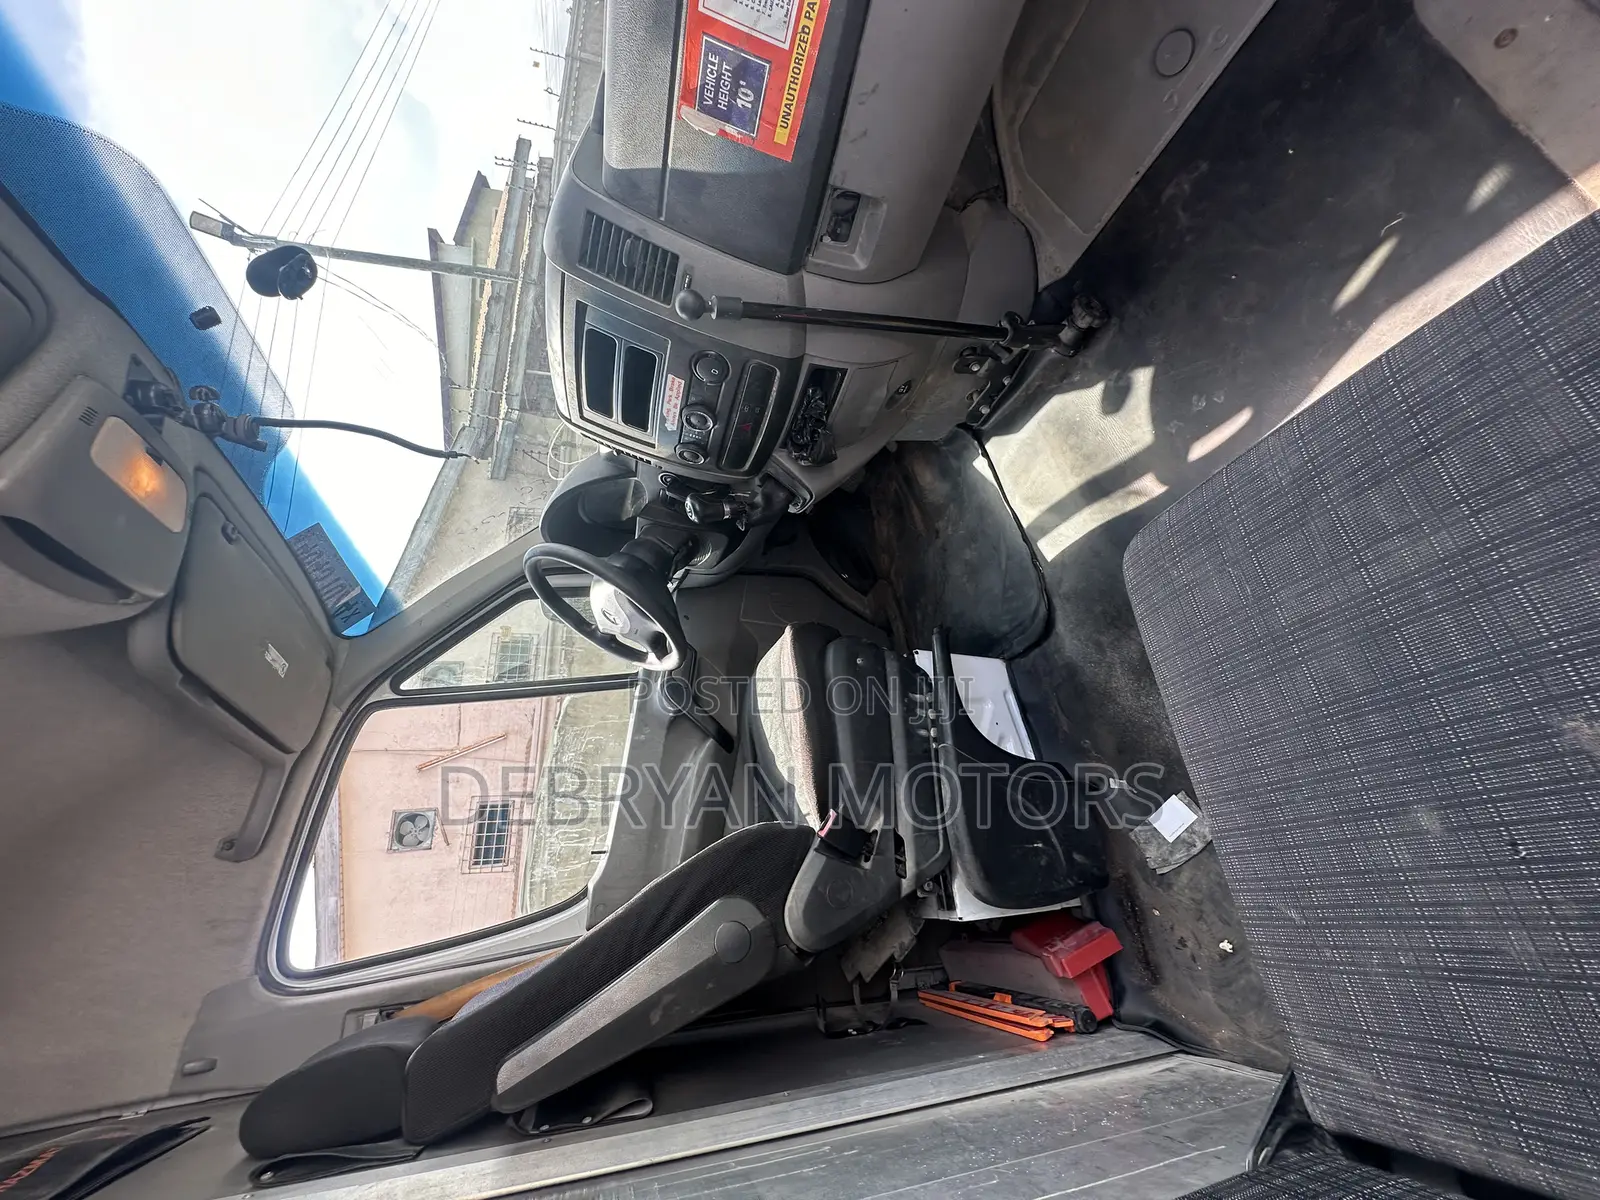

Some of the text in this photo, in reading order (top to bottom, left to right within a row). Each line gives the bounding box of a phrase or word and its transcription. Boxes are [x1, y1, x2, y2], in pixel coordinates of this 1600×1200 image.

[702, 52, 720, 106] VEHICLE
[718, 62, 734, 110] HEIGHT
[779, 25, 811, 130] UNAUTHORIZED
